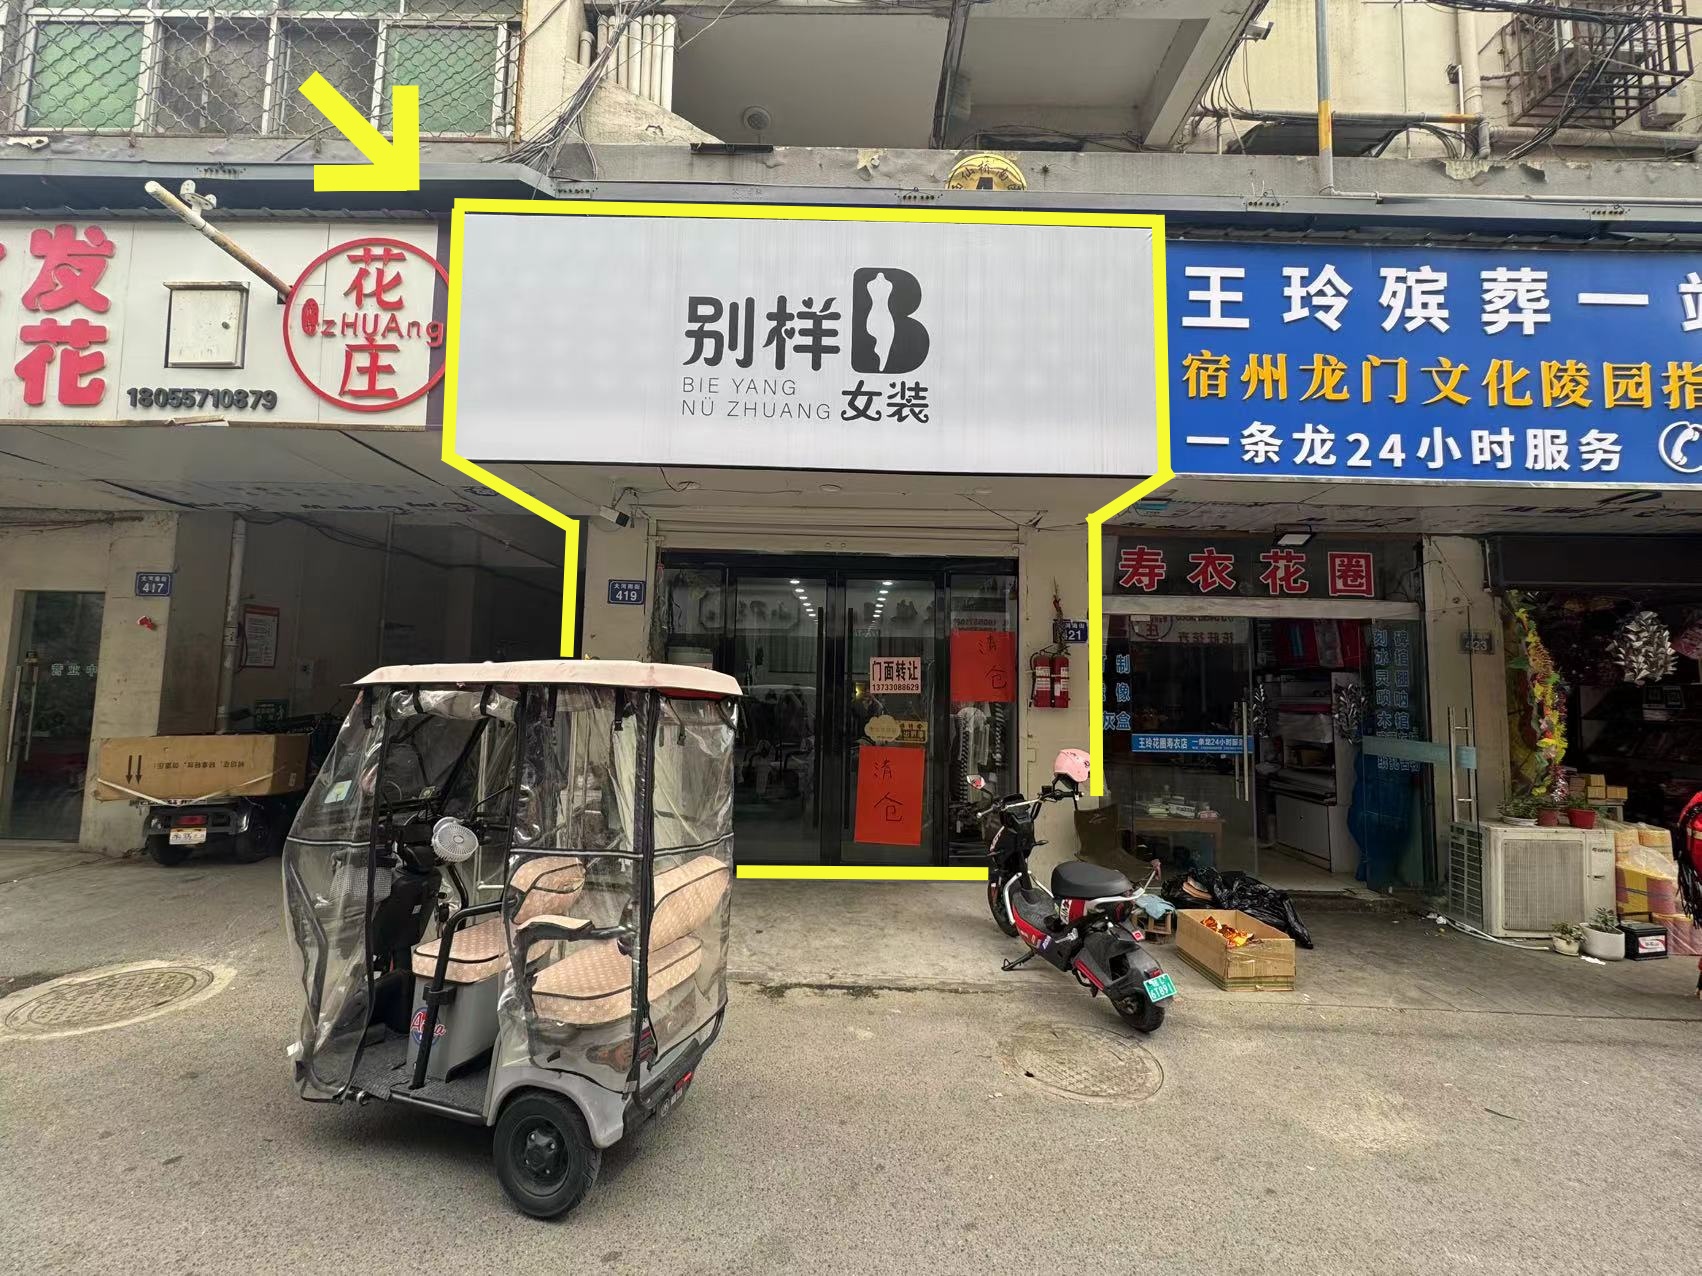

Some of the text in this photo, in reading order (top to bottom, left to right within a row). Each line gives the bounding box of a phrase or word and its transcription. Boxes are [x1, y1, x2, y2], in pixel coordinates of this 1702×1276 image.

[0, 224, 117, 314] 发
[342, 247, 407, 311] 花
[682, 267, 930, 374] 别样 B
[14, 317, 110, 407] 花
[339, 342, 401, 399] 庄
[1181, 349, 1702, 411] 宿州龙门文化陵园指
[126, 386, 278, 411] 18055710879
[681, 396, 831, 420] NÜ ZHUANG
[682, 376, 797, 396] BIE YANG
[840, 379, 930, 424] 女装
[1185, 420, 1624, 473] 一条龙24小时服务
[142, 582, 165, 593] 417
[1118, 545, 1376, 598] 寿衣花圈
[615, 590, 638, 601] 419
[1064, 630, 1081, 641] 21
[872, 660, 919, 682] 门面转让
[410, 1011, 447, 1036] Aa
